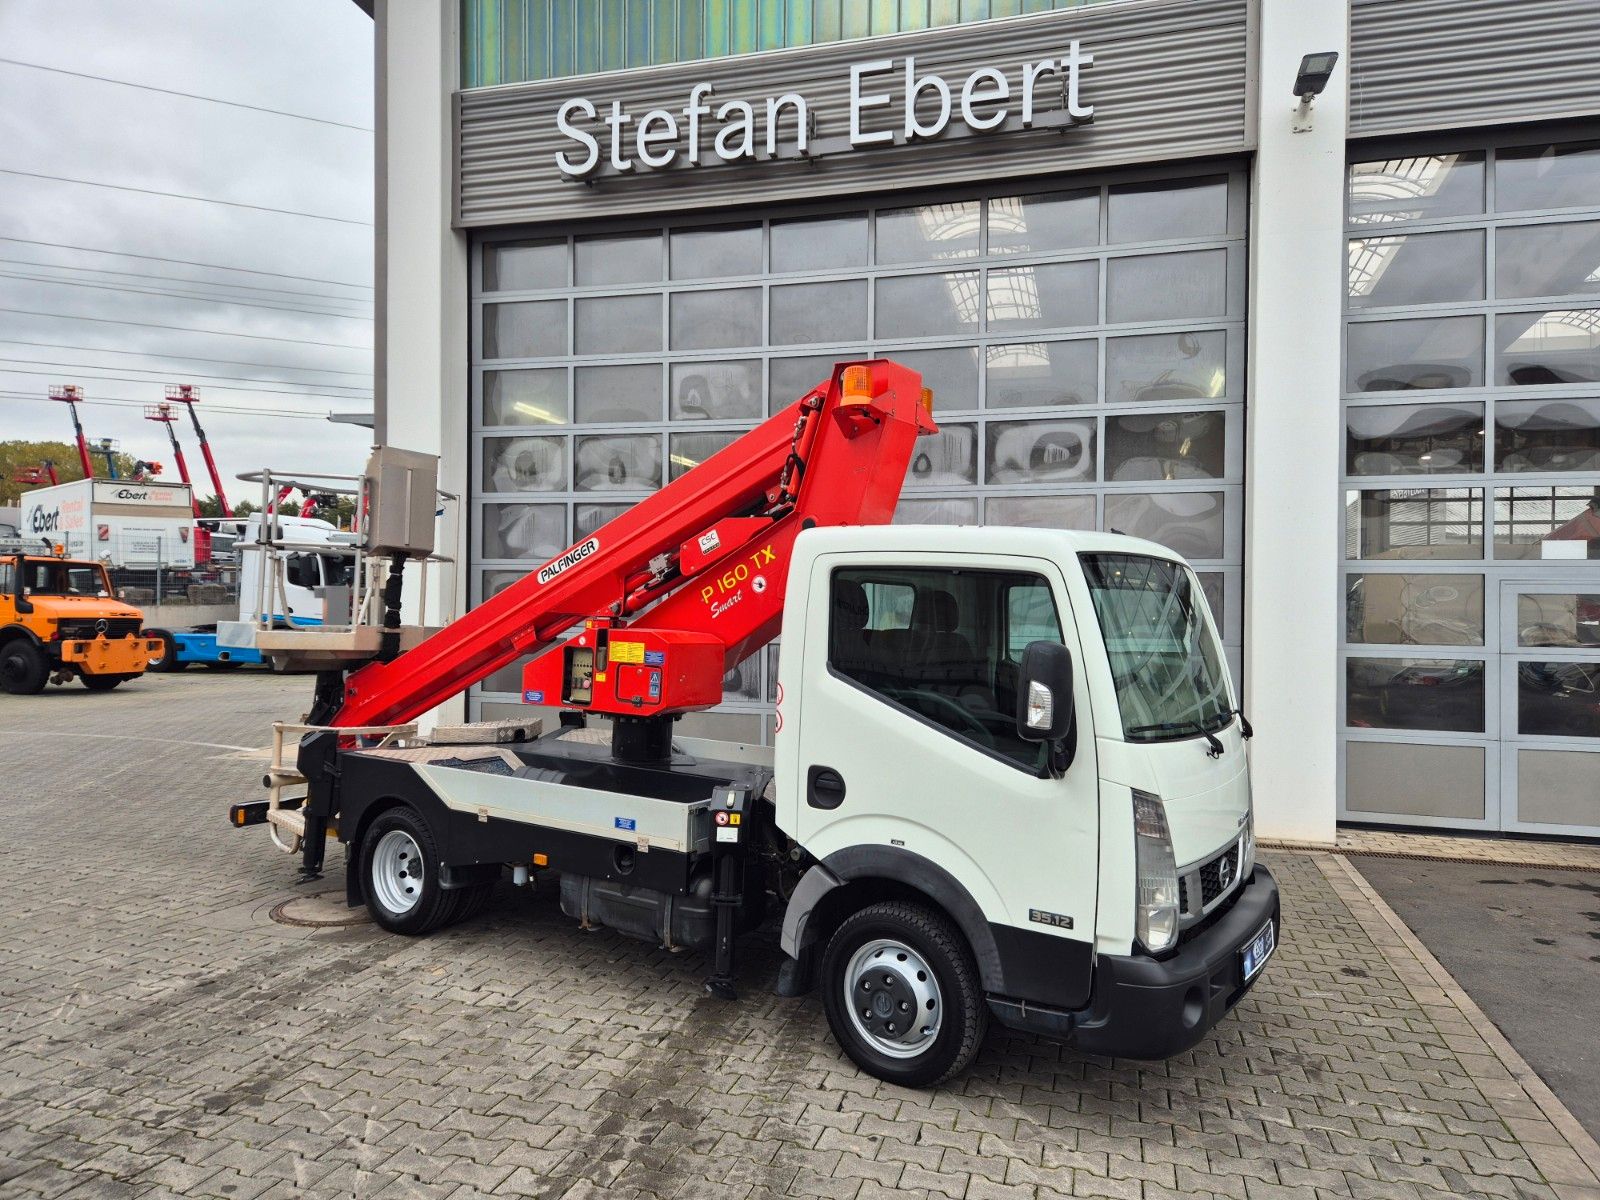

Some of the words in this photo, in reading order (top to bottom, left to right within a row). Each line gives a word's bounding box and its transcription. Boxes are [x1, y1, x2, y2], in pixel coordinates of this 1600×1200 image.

[555, 82, 809, 179] Stefan
[849, 40, 1096, 148] Ebert
[117, 489, 147, 500] Ebert
[32, 504, 59, 534] Ebert
[540, 540, 596, 582] PALFINGER
[701, 585, 714, 604] P
[717, 563, 748, 594] 160
[749, 544, 776, 569] TX
[710, 589, 743, 619] Smart
[1031, 910, 1071, 928] 35.12
